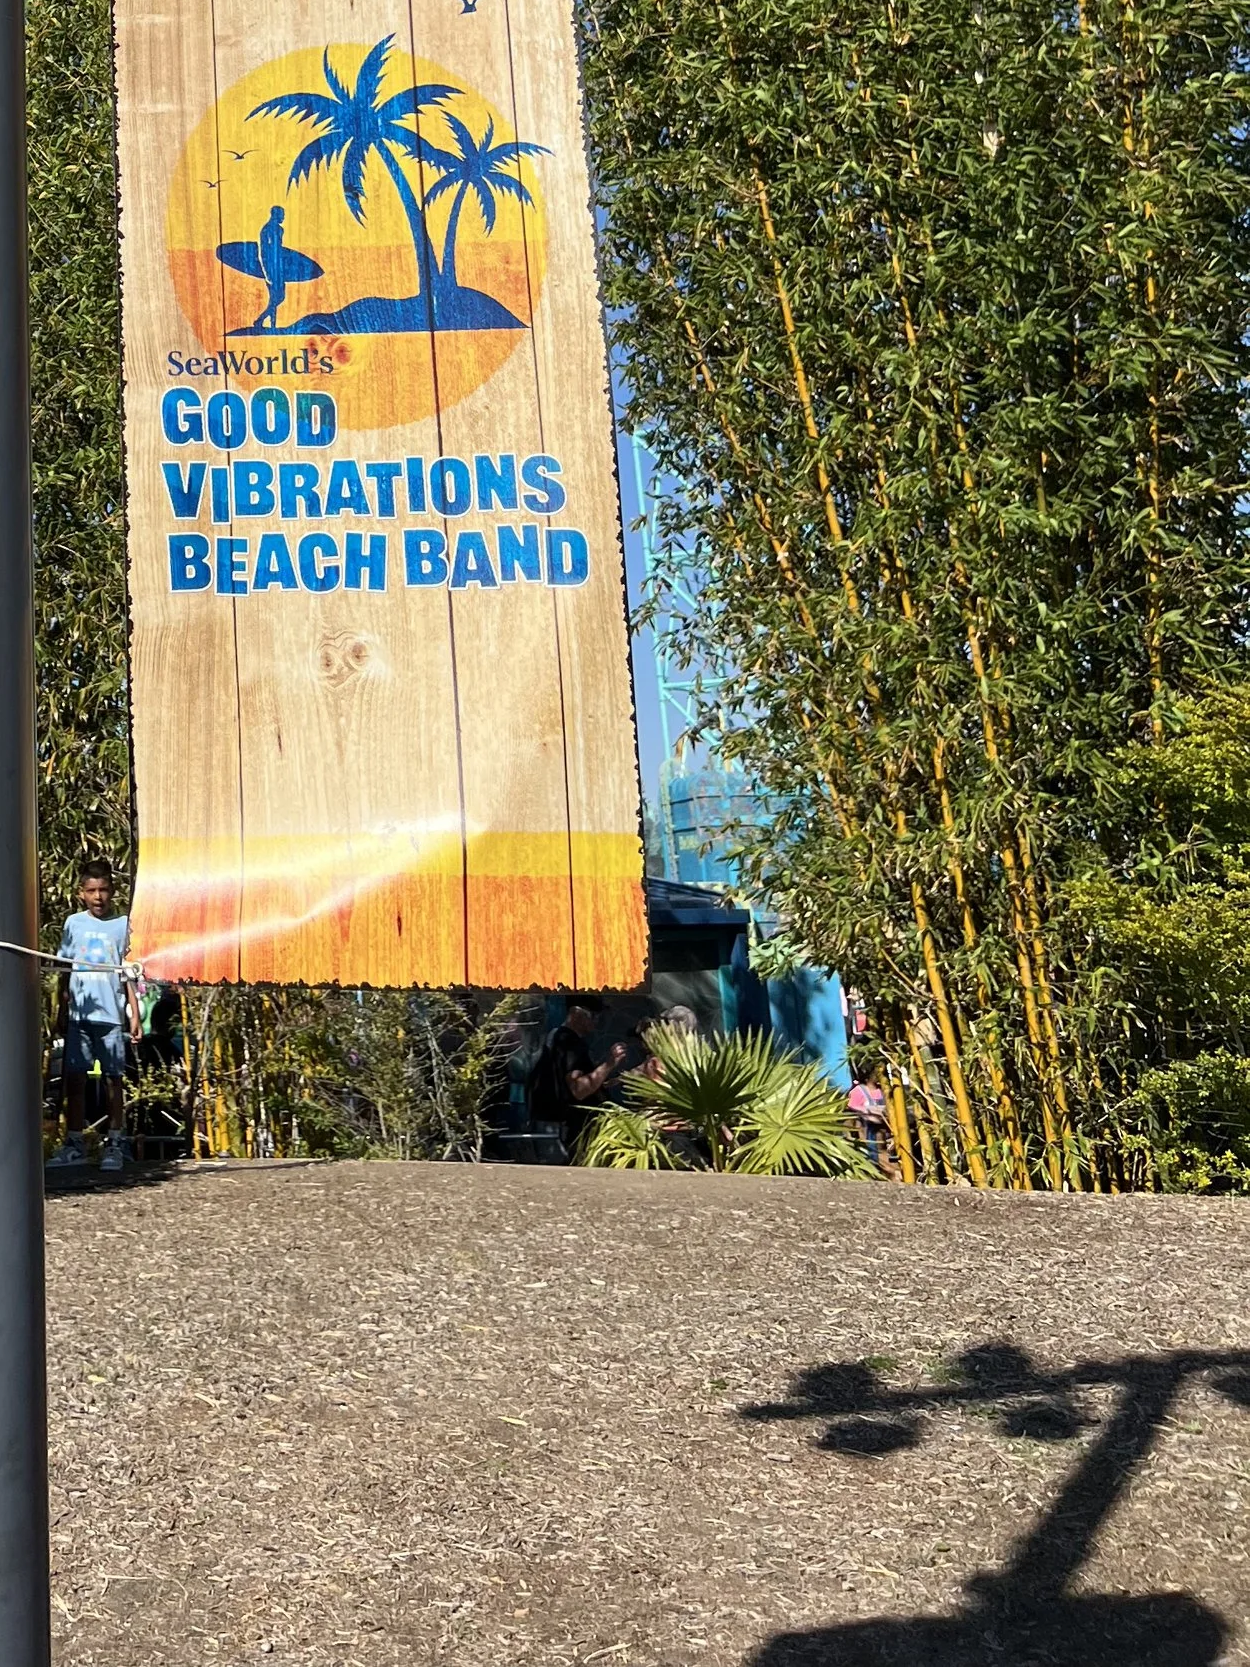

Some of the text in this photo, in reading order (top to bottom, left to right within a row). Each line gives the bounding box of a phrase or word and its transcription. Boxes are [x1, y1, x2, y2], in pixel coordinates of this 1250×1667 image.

[167, 348, 334, 376] SeaWorld's
[161, 387, 338, 450] GOOD
[161, 454, 567, 524] VIBRATIONS
[167, 524, 590, 596] BEACH BAND
